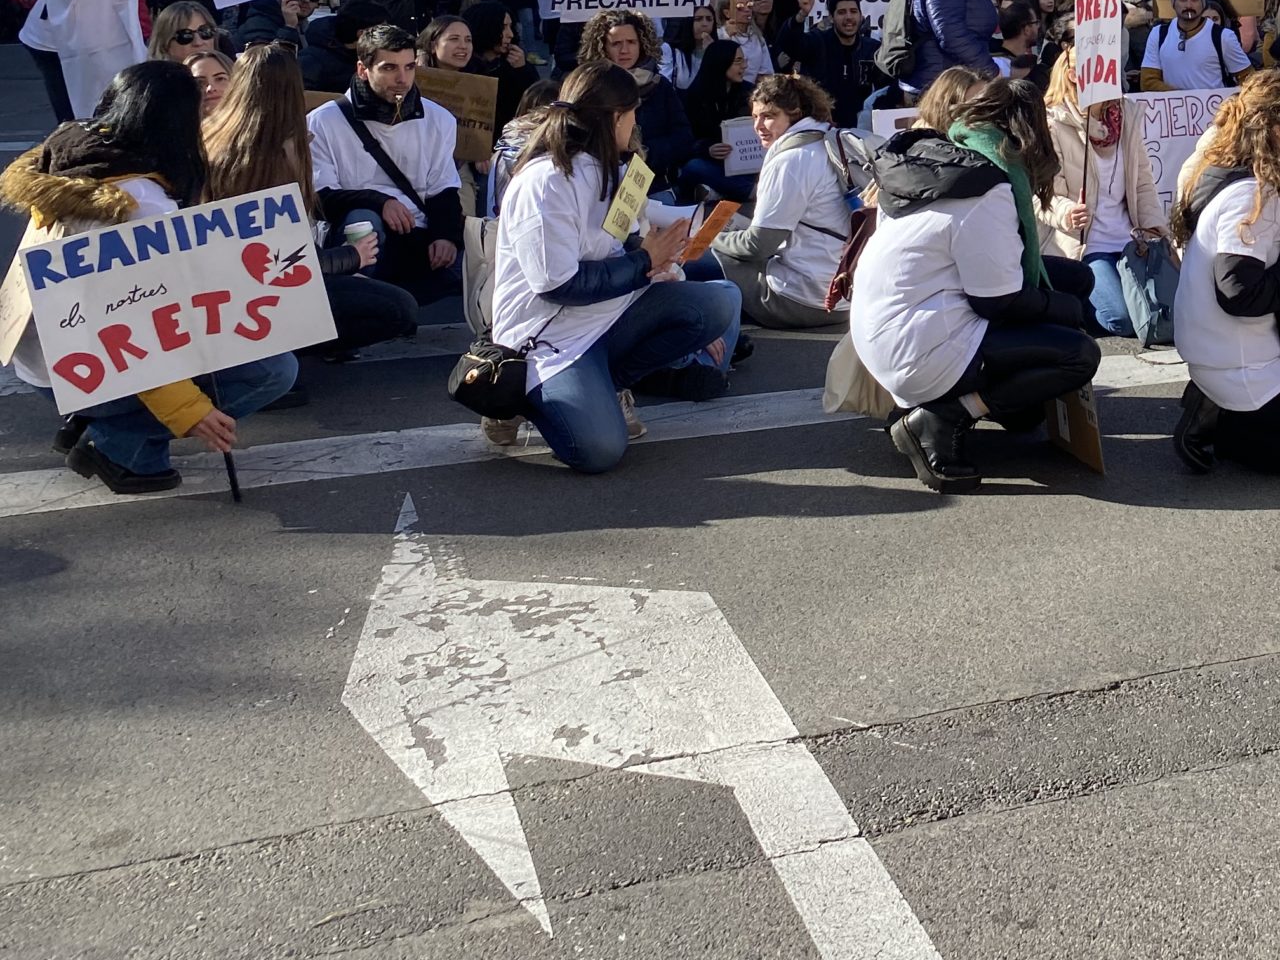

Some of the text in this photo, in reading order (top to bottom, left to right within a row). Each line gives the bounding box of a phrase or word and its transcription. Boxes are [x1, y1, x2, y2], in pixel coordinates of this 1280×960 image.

[1078, 54, 1118, 93] VIDA
[26, 194, 301, 290] REANIMEM
[59, 283, 168, 329] els nostres
[53, 290, 281, 395] DRETS
